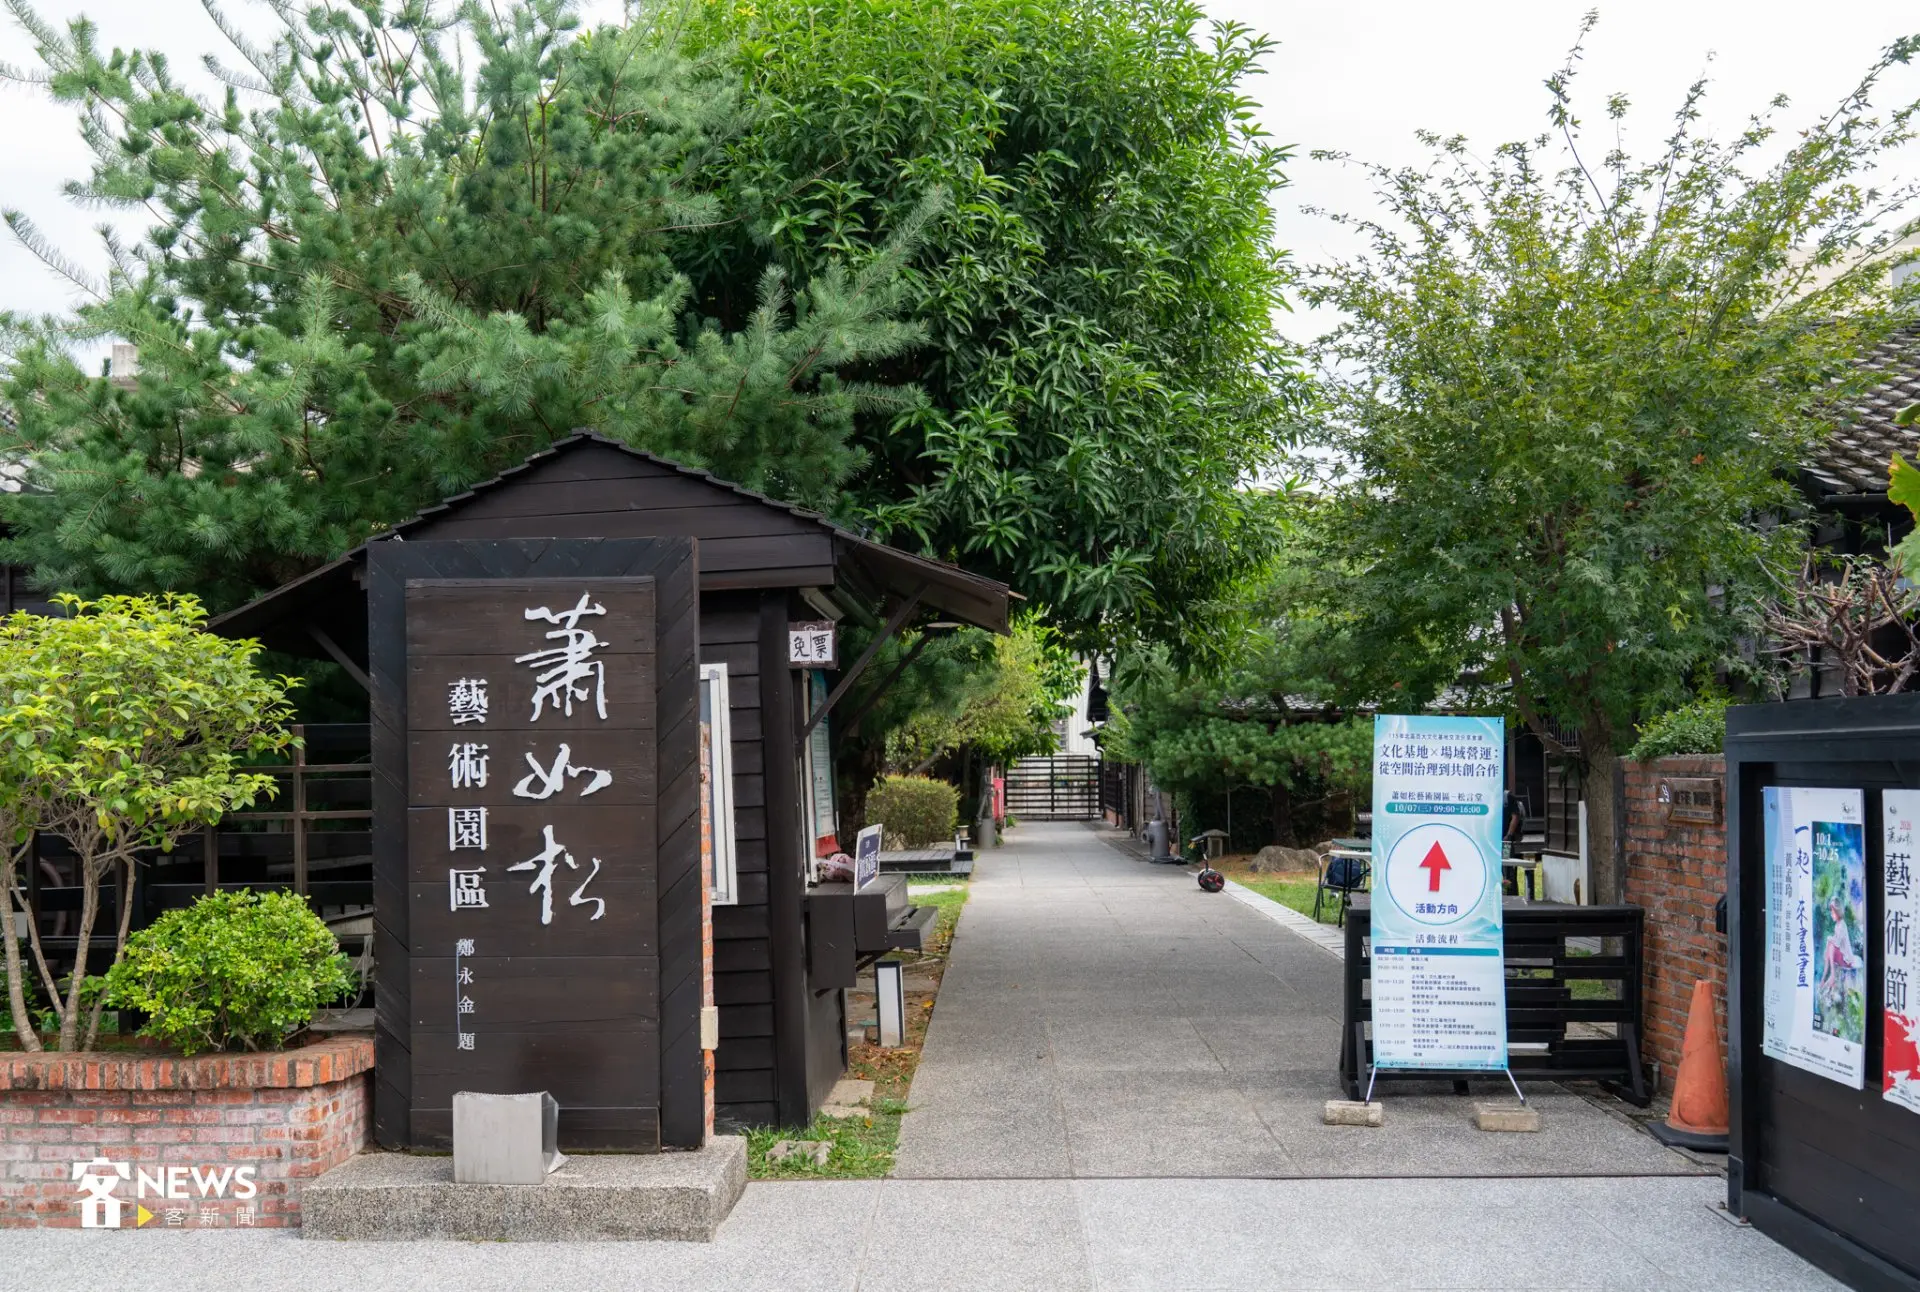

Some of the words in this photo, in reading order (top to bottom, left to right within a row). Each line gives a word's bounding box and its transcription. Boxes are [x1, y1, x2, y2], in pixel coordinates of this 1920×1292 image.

[793, 633, 830, 659] 免票
[507, 594, 613, 926] 蕭如松
[1379, 761, 1499, 777] 從空間治理到共創合作
[447, 678, 491, 912] 藝術園區
[1415, 903, 1459, 915] 活動方向
[1415, 934, 1459, 944] 活動流程
[1885, 853, 1911, 1014] 藝術節
